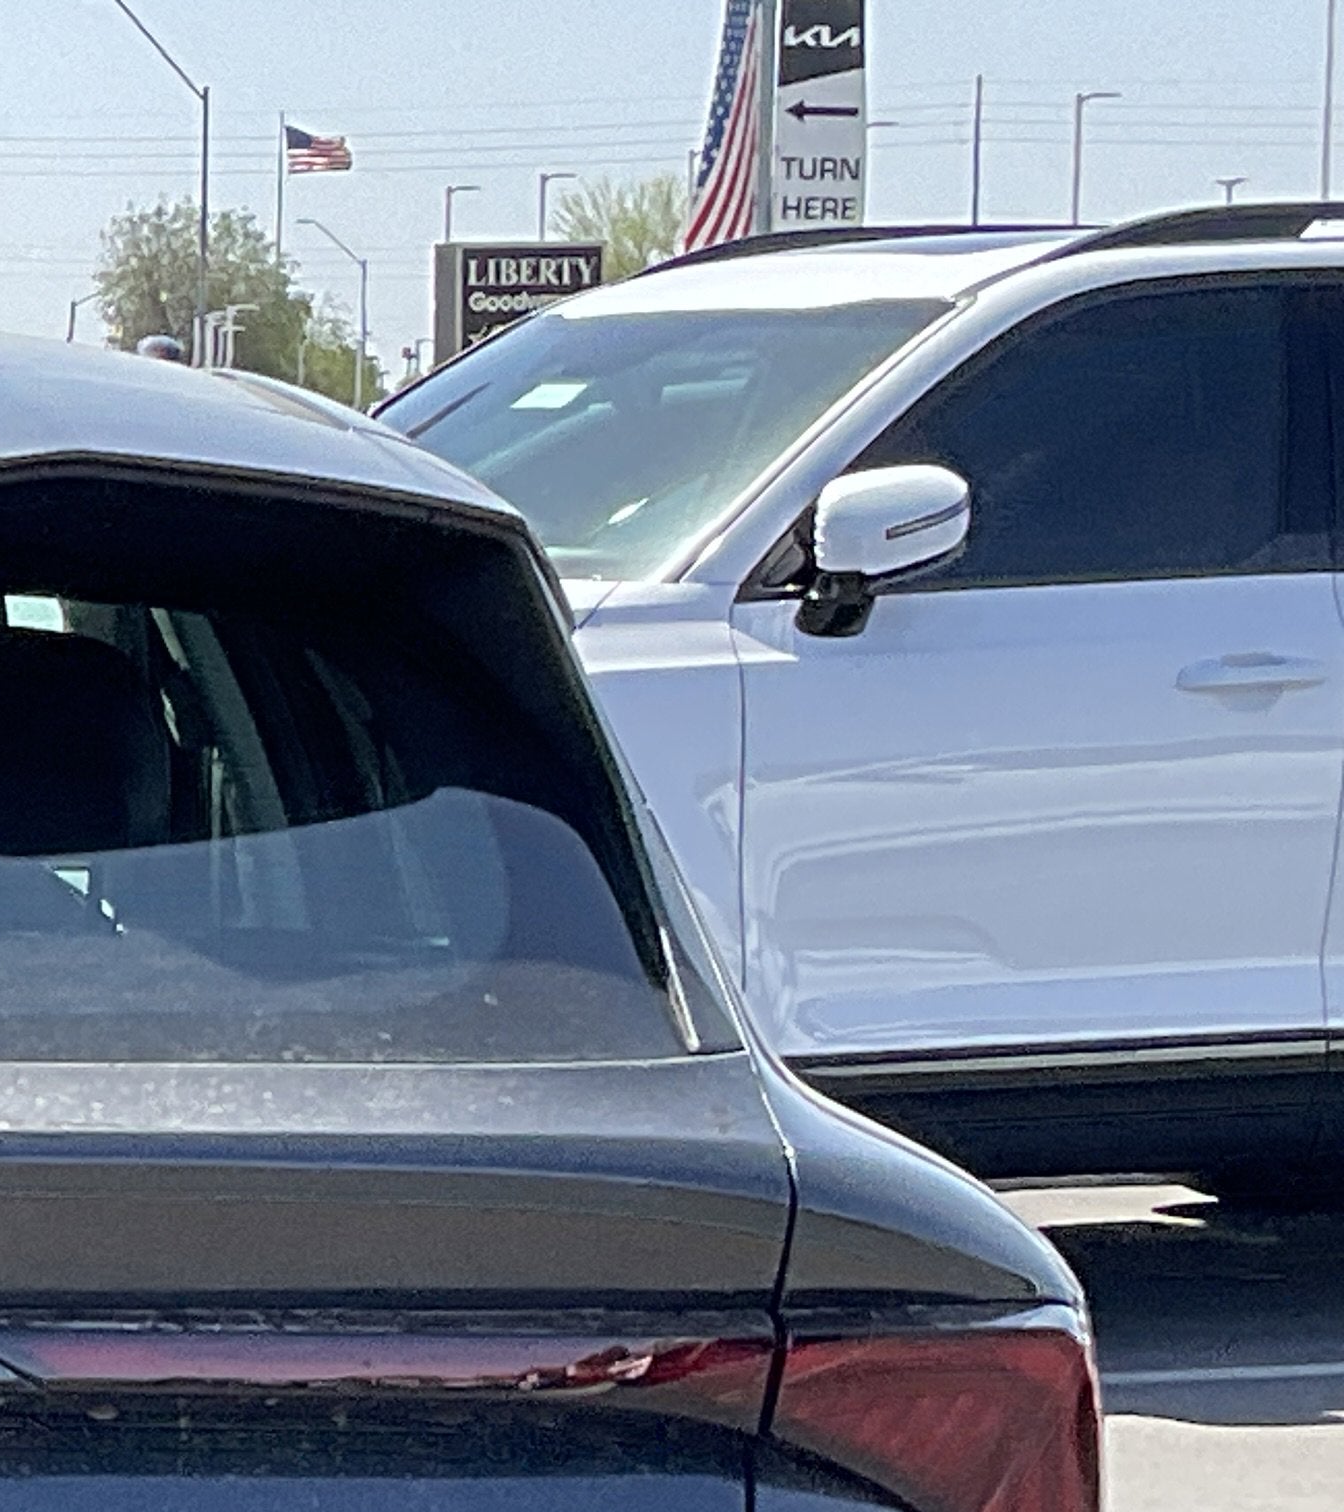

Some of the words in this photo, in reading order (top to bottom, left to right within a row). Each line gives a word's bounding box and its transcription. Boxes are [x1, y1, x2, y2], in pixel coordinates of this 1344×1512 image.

[784, 24, 861, 47] KIA
[780, 156, 861, 181] TURN
[781, 196, 857, 220] HERE
[468, 255, 599, 287] LIBERTY
